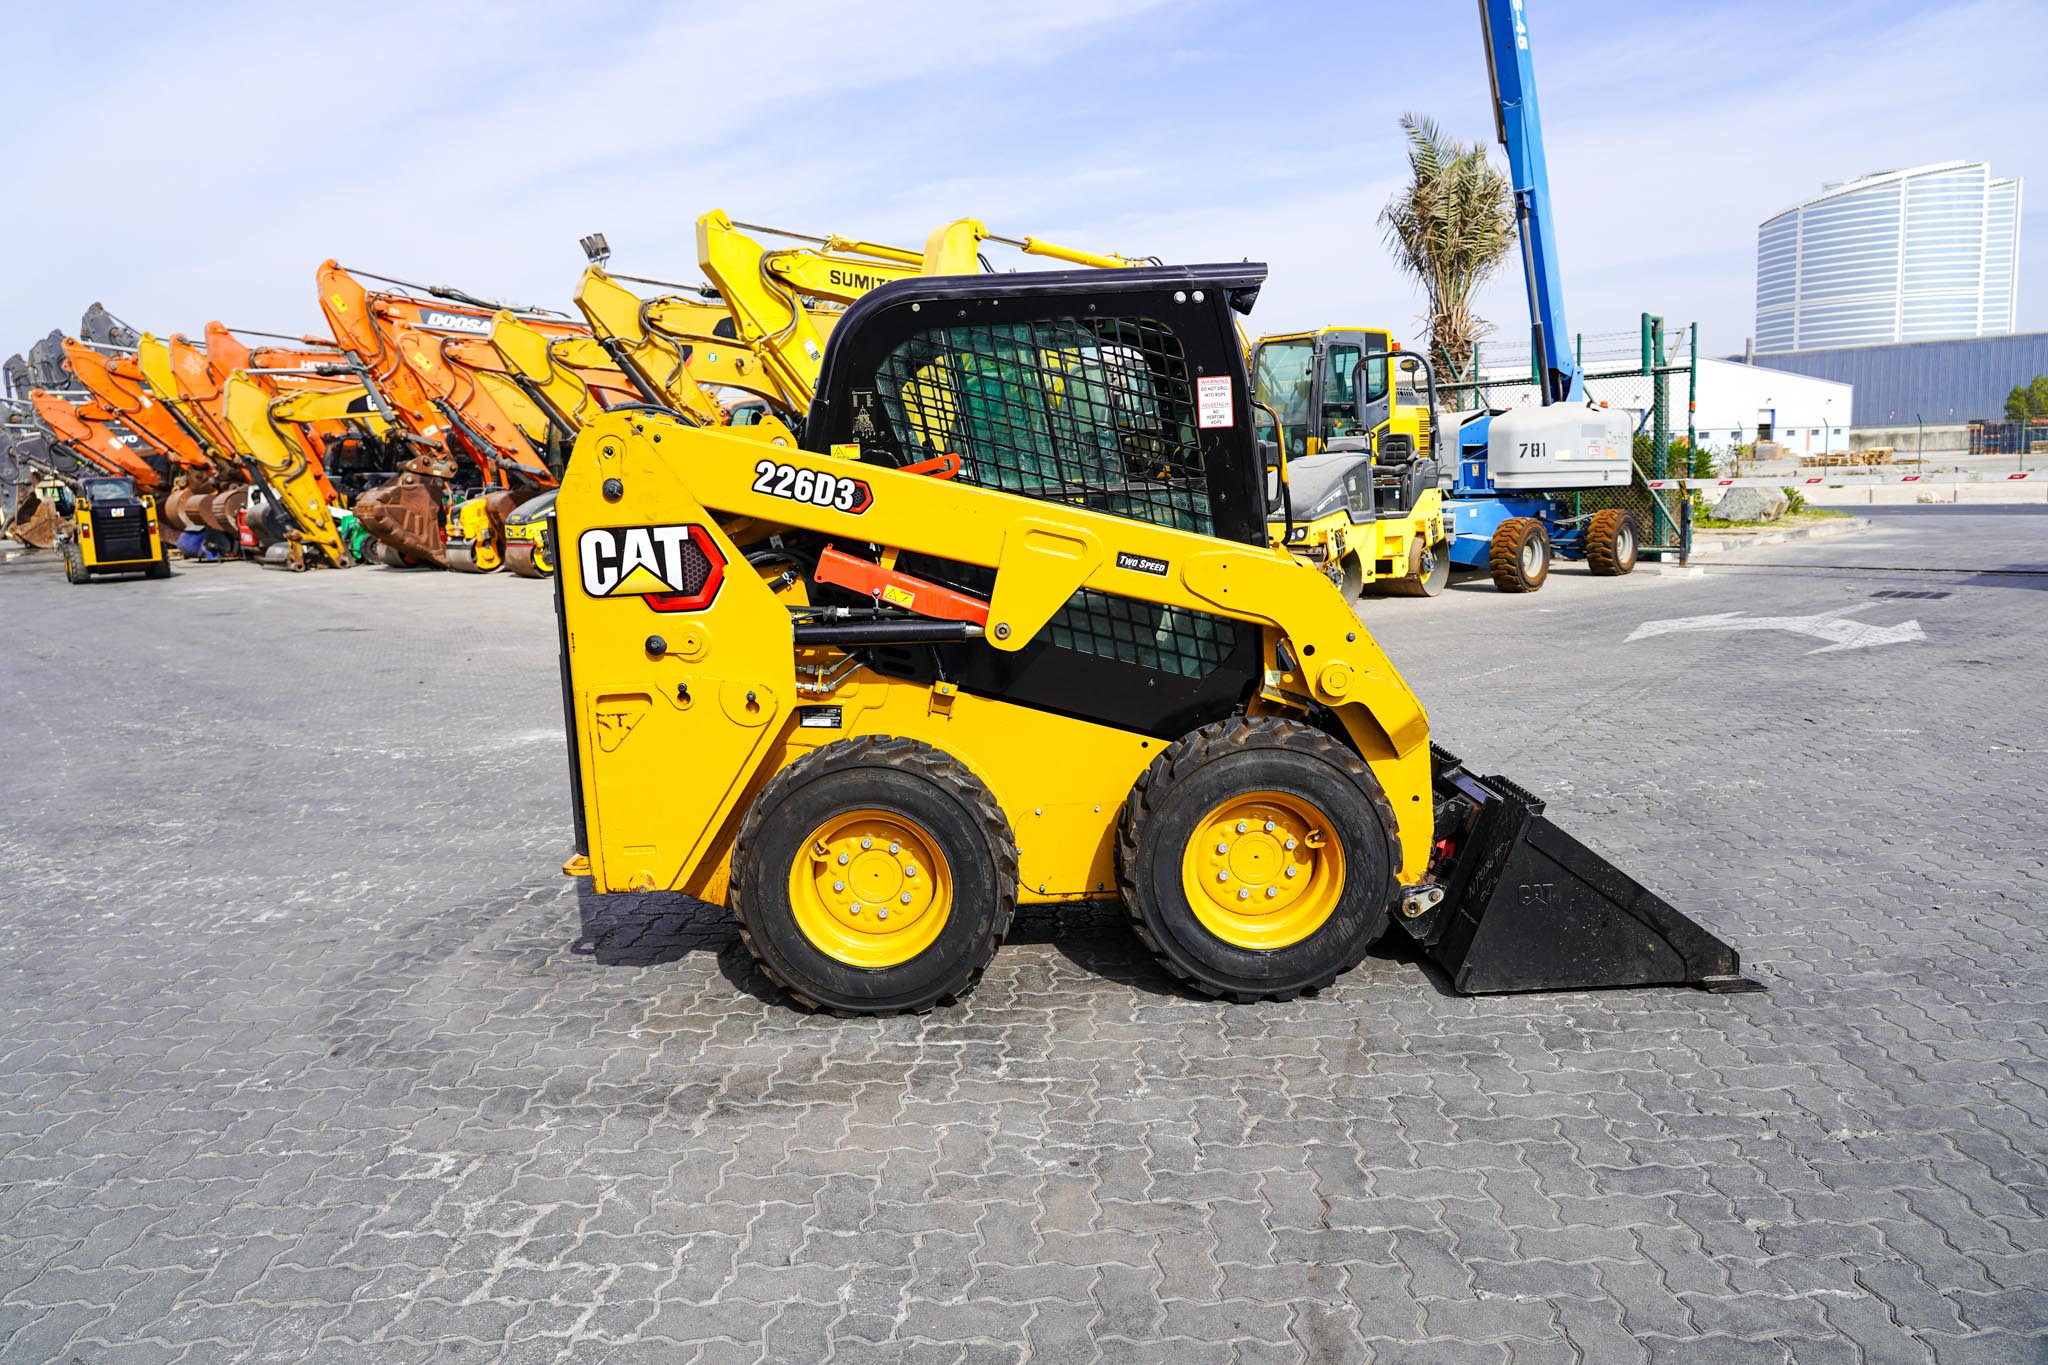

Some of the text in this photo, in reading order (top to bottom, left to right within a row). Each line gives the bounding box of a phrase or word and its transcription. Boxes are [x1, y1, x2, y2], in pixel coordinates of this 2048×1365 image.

[830, 269, 892, 290] SUMIT
[427, 312, 492, 330] DOOSA
[1519, 442, 1546, 459] 781
[752, 460, 857, 511] 226D3
[111, 507, 125, 517] CAT
[579, 525, 690, 596] CAT
